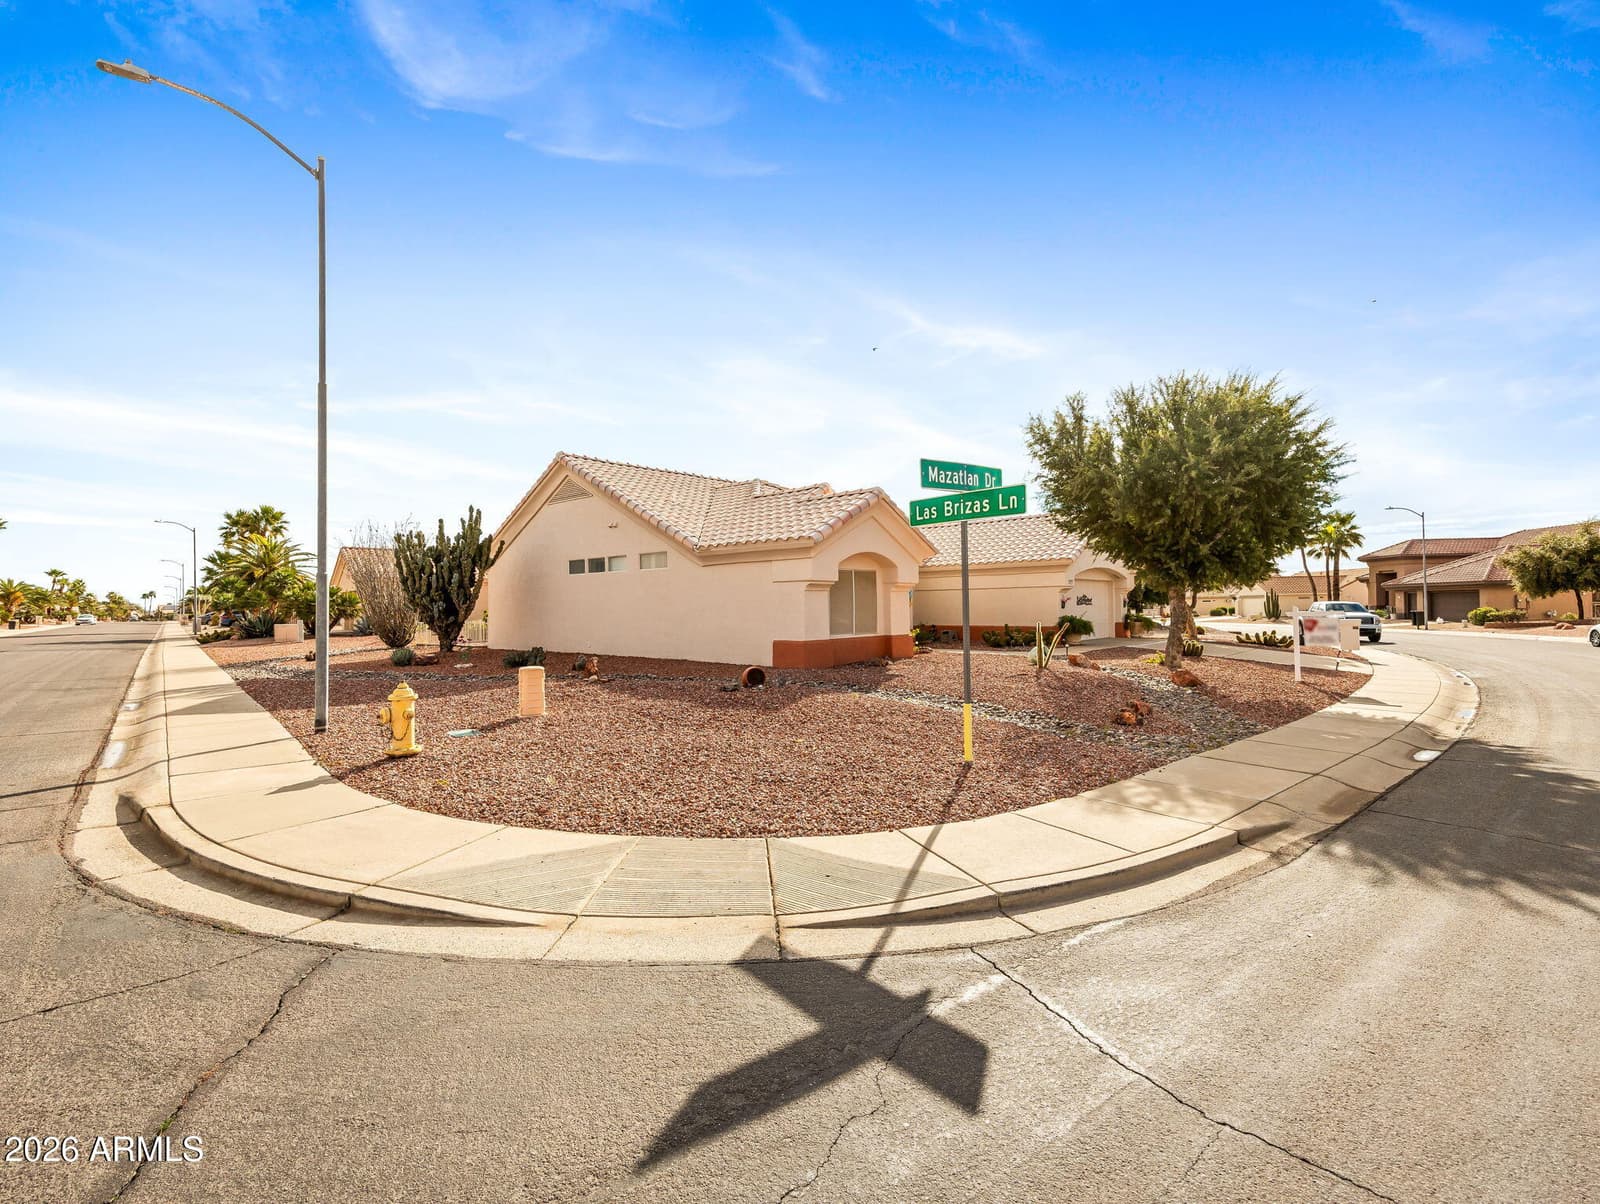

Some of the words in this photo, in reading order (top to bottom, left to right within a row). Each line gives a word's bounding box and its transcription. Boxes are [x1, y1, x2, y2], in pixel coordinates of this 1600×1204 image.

[928, 466, 979, 486] Mazatlan
[985, 472, 996, 488] Dr
[916, 505, 937, 520] Las
[944, 498, 990, 516] Brizas
[998, 493, 1018, 510] Ln
